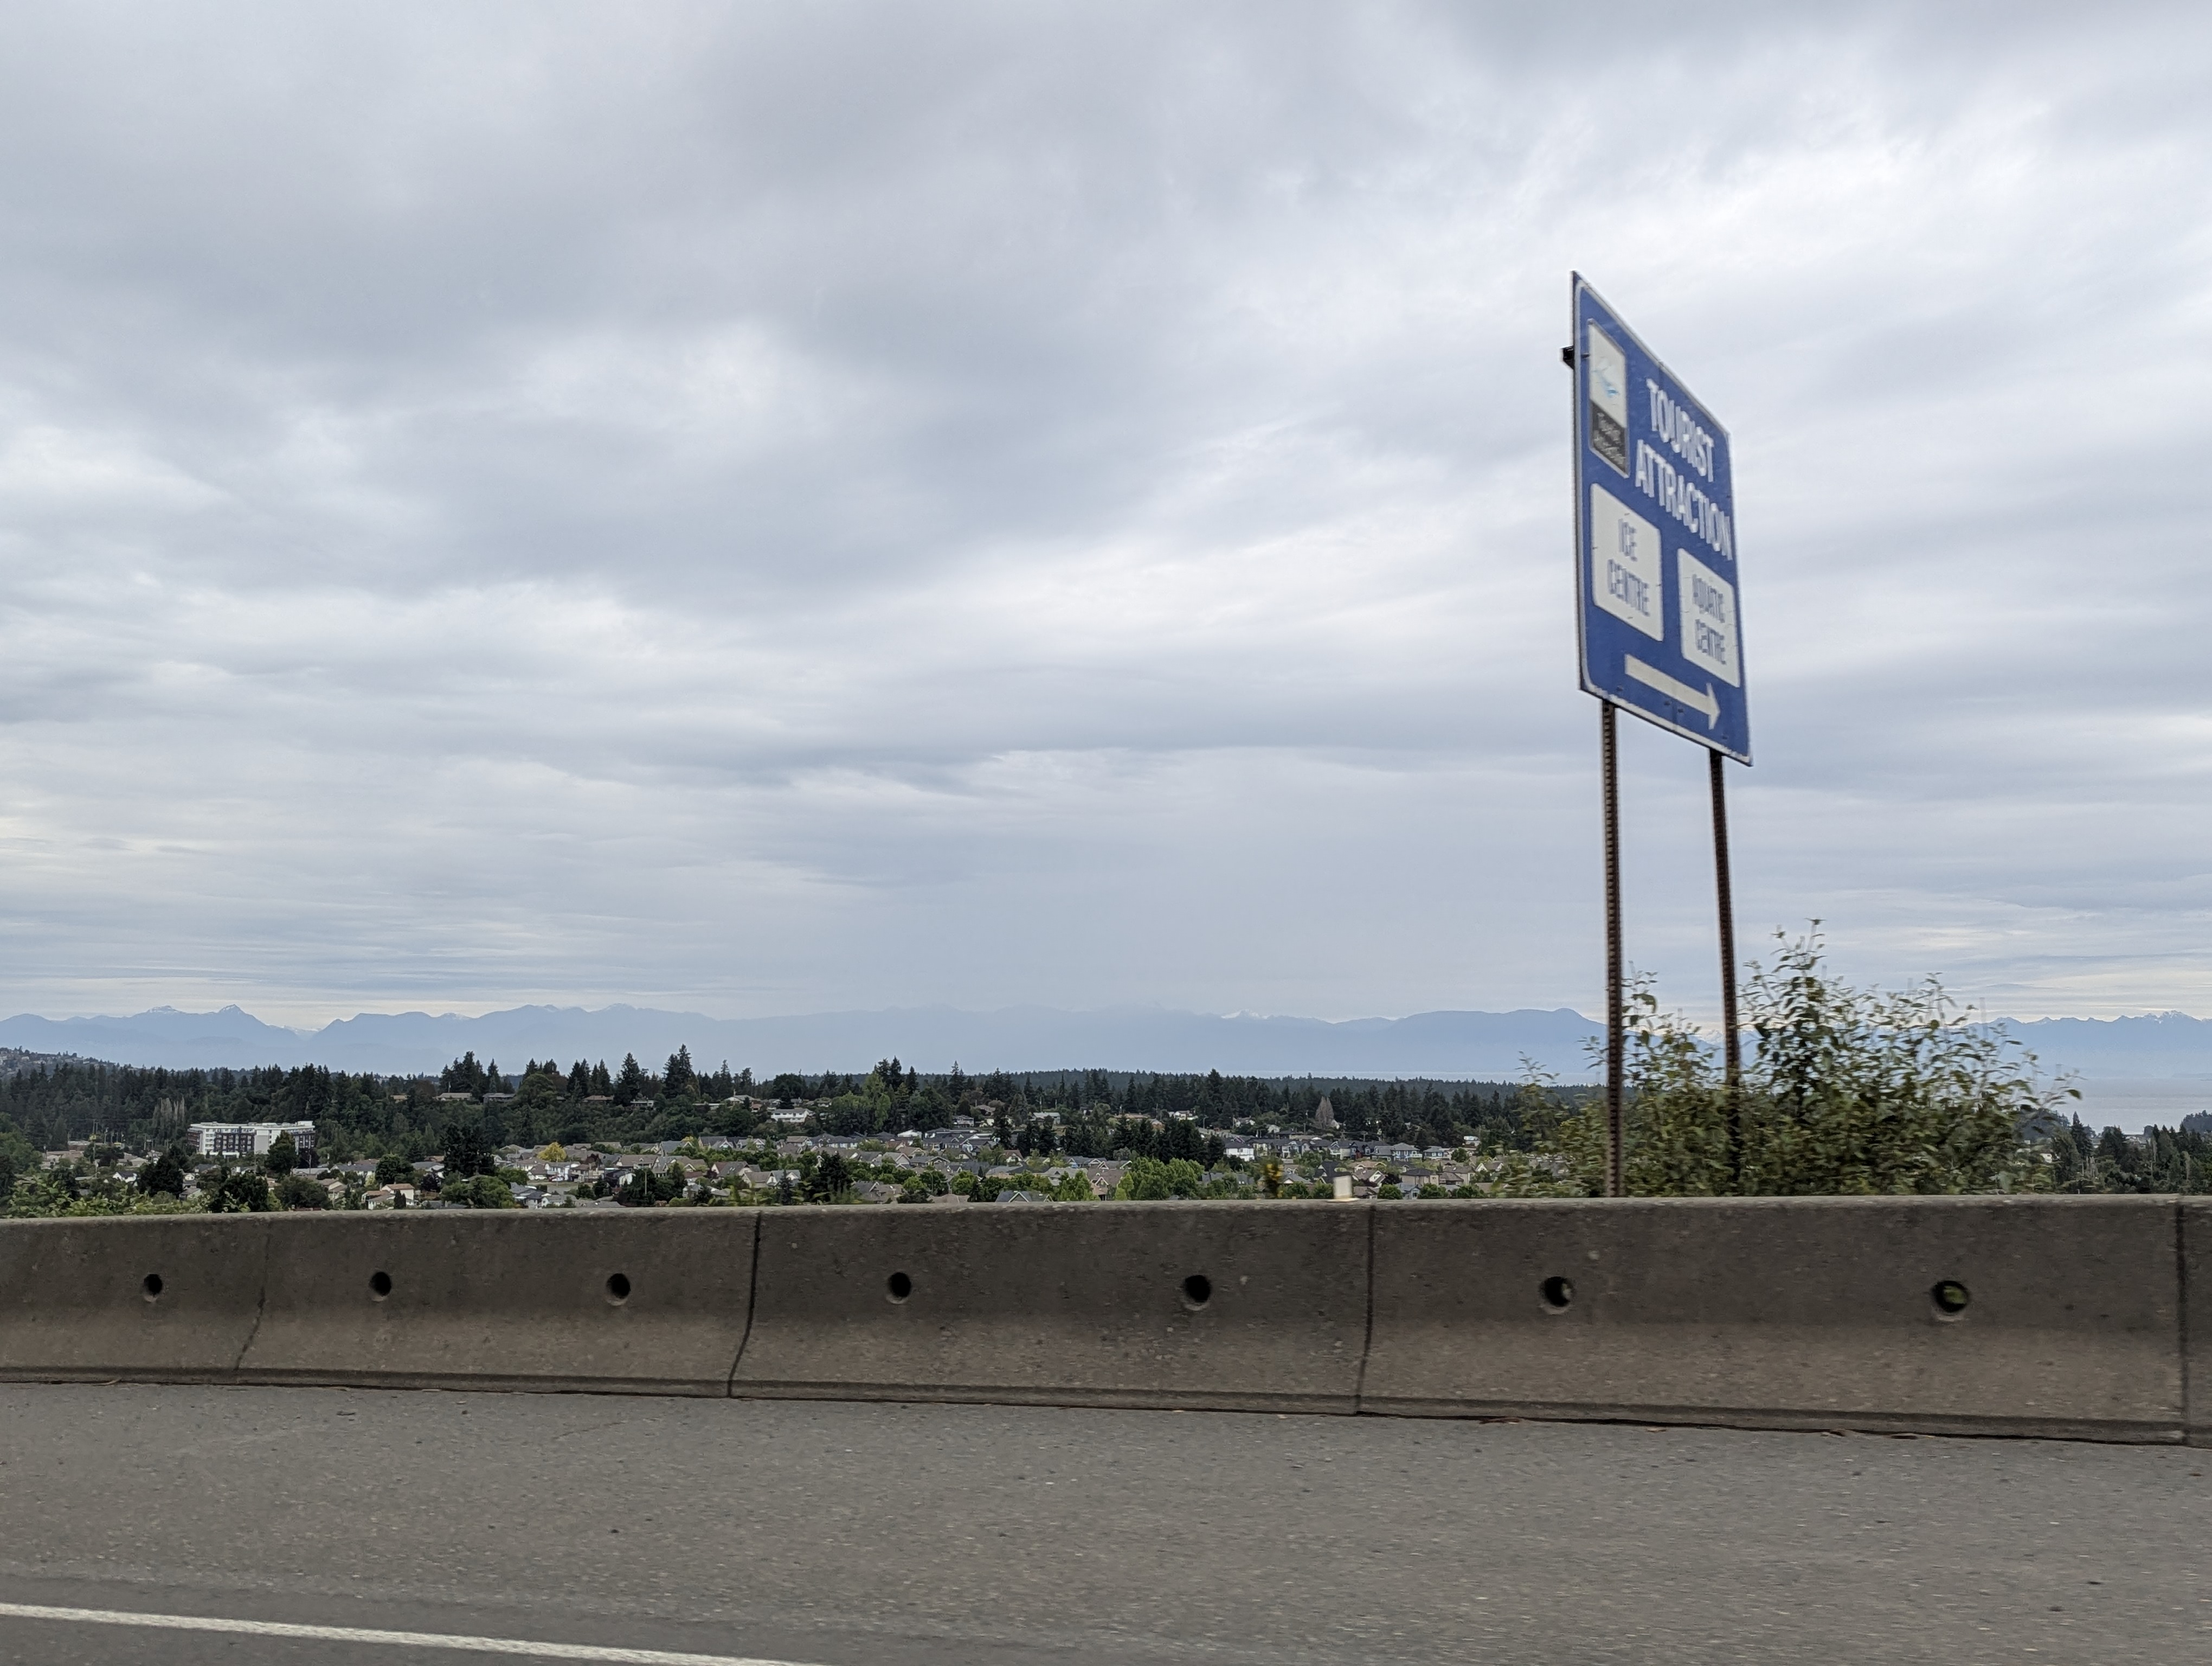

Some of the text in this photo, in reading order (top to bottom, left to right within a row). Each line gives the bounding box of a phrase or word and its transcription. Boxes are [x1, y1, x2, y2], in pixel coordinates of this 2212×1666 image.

[1646, 379, 1714, 482] TOURIST
[1635, 439, 1733, 560] ATTRACTION
[1618, 518, 1637, 561] ICE
[1607, 559, 1650, 617] CENTRE
[1695, 618, 1726, 665] CENTRE
